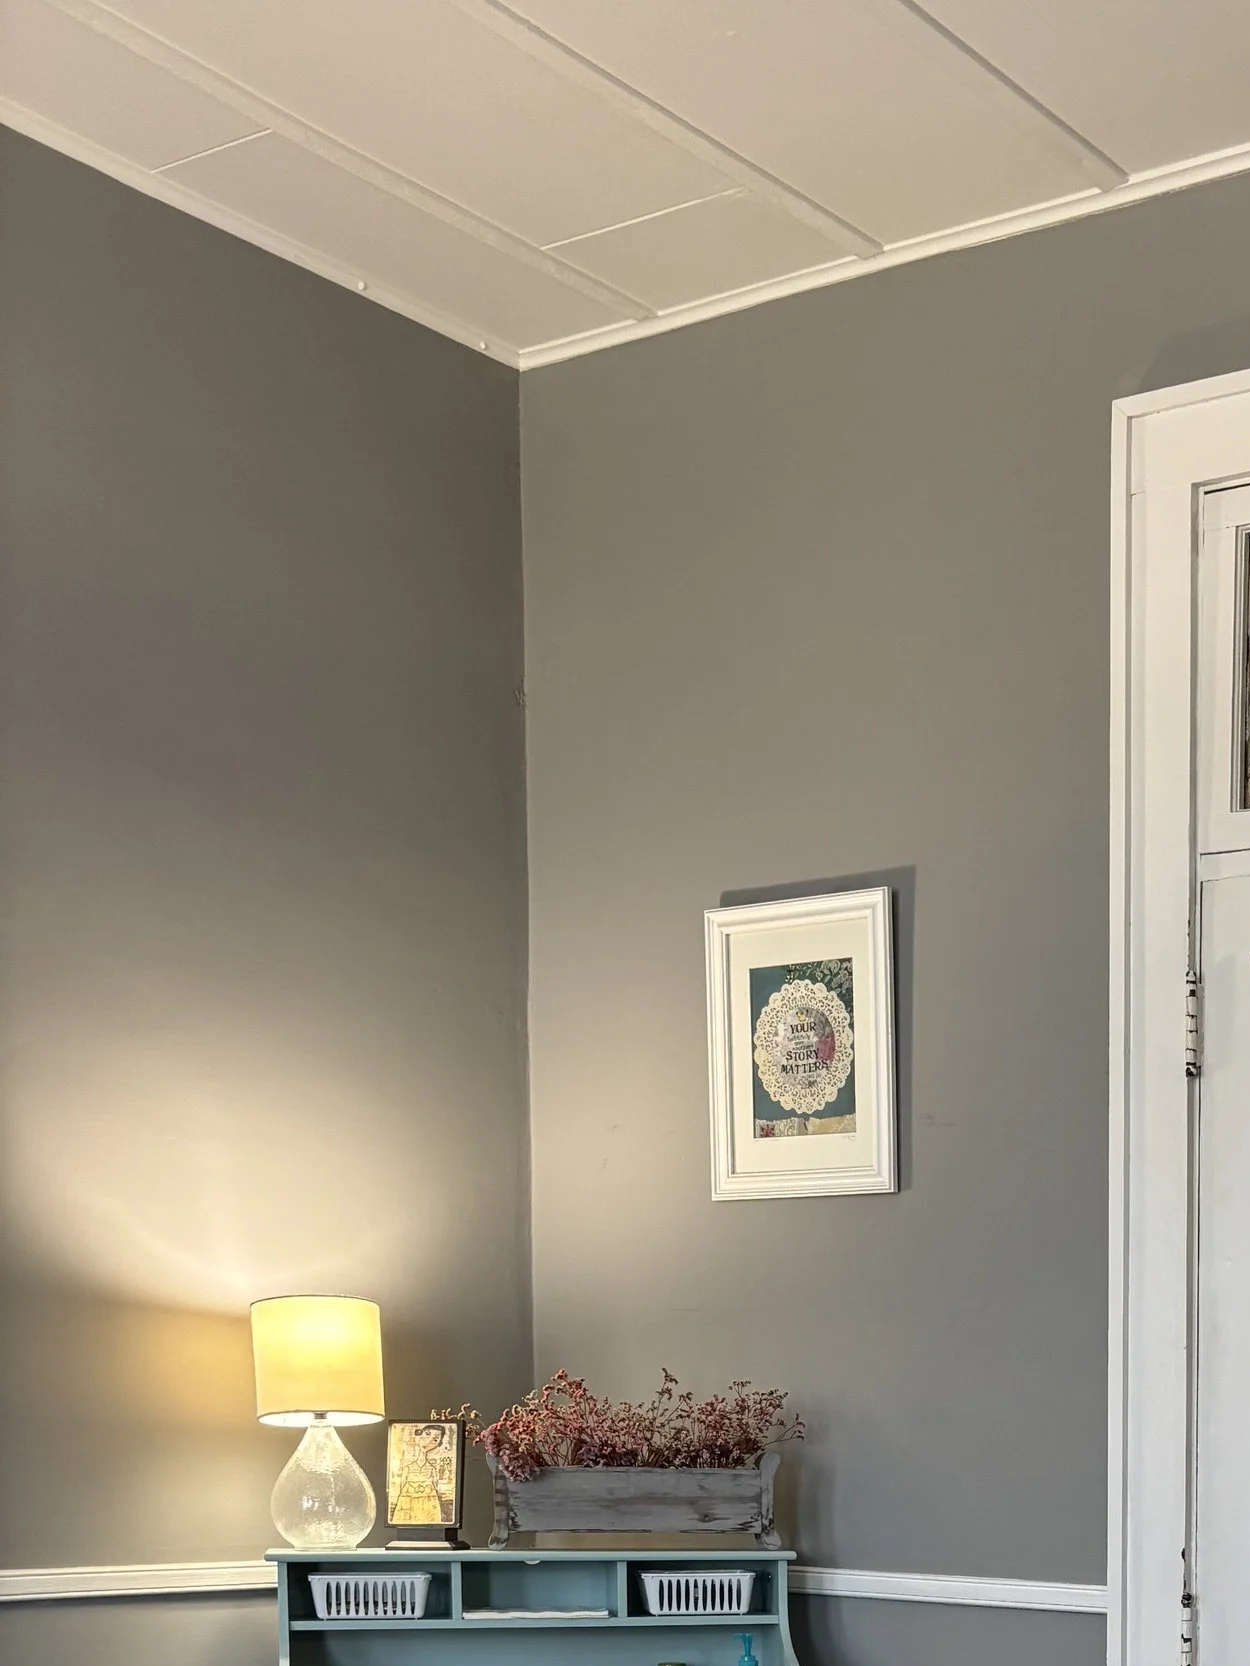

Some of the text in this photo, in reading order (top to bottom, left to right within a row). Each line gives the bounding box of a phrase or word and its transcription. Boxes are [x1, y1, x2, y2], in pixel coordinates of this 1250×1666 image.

[790, 1021, 817, 1034] YOUR
[786, 1048, 819, 1062] STORY
[781, 1059, 829, 1074] MATTERS
